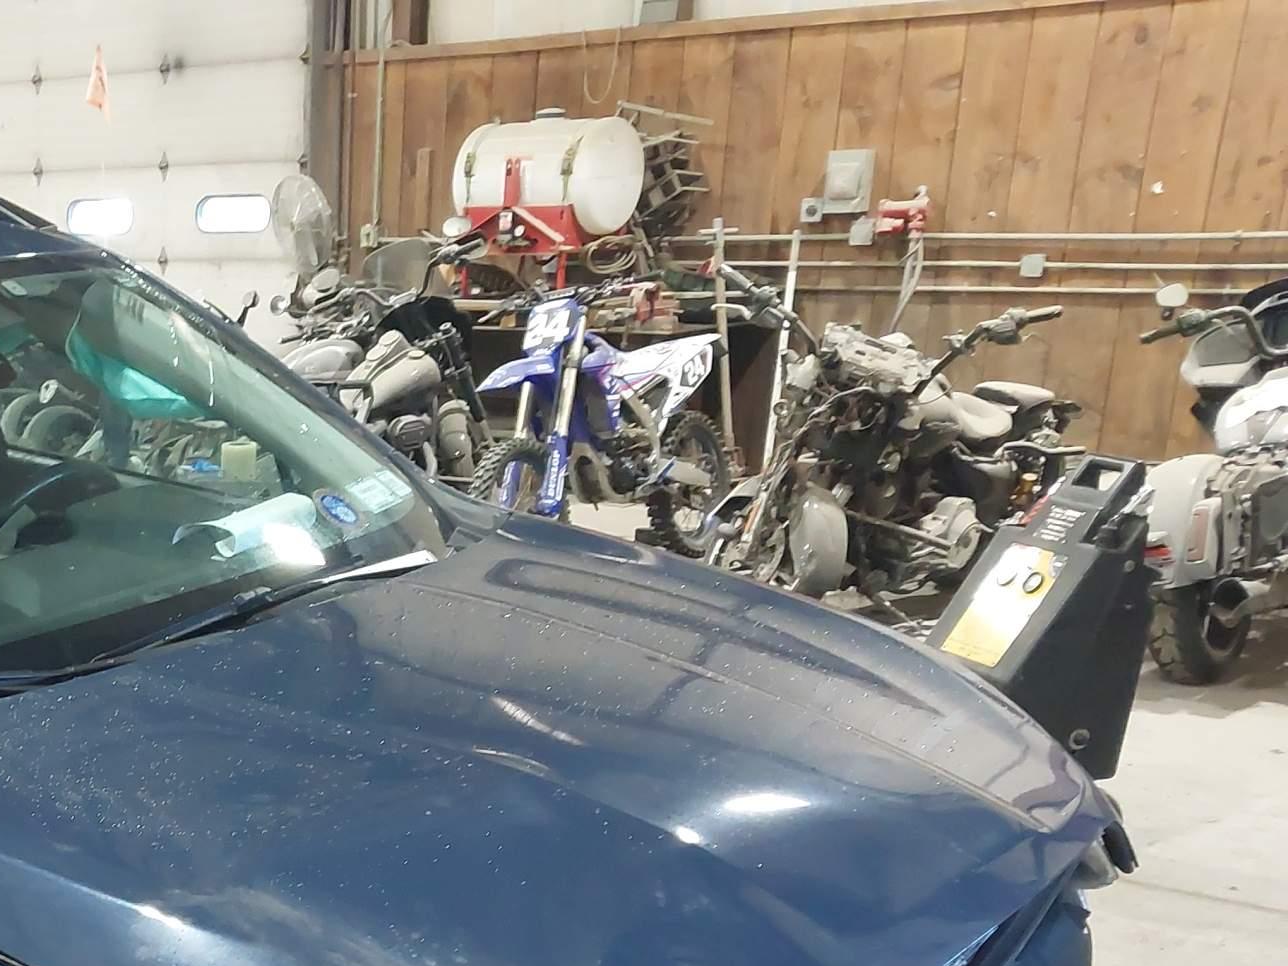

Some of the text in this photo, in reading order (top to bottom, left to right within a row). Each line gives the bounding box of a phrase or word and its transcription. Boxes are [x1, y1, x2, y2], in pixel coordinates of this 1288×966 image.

[523, 310, 570, 350] 24
[684, 354, 705, 386] 24
[546, 449, 561, 498] DUNLOP
